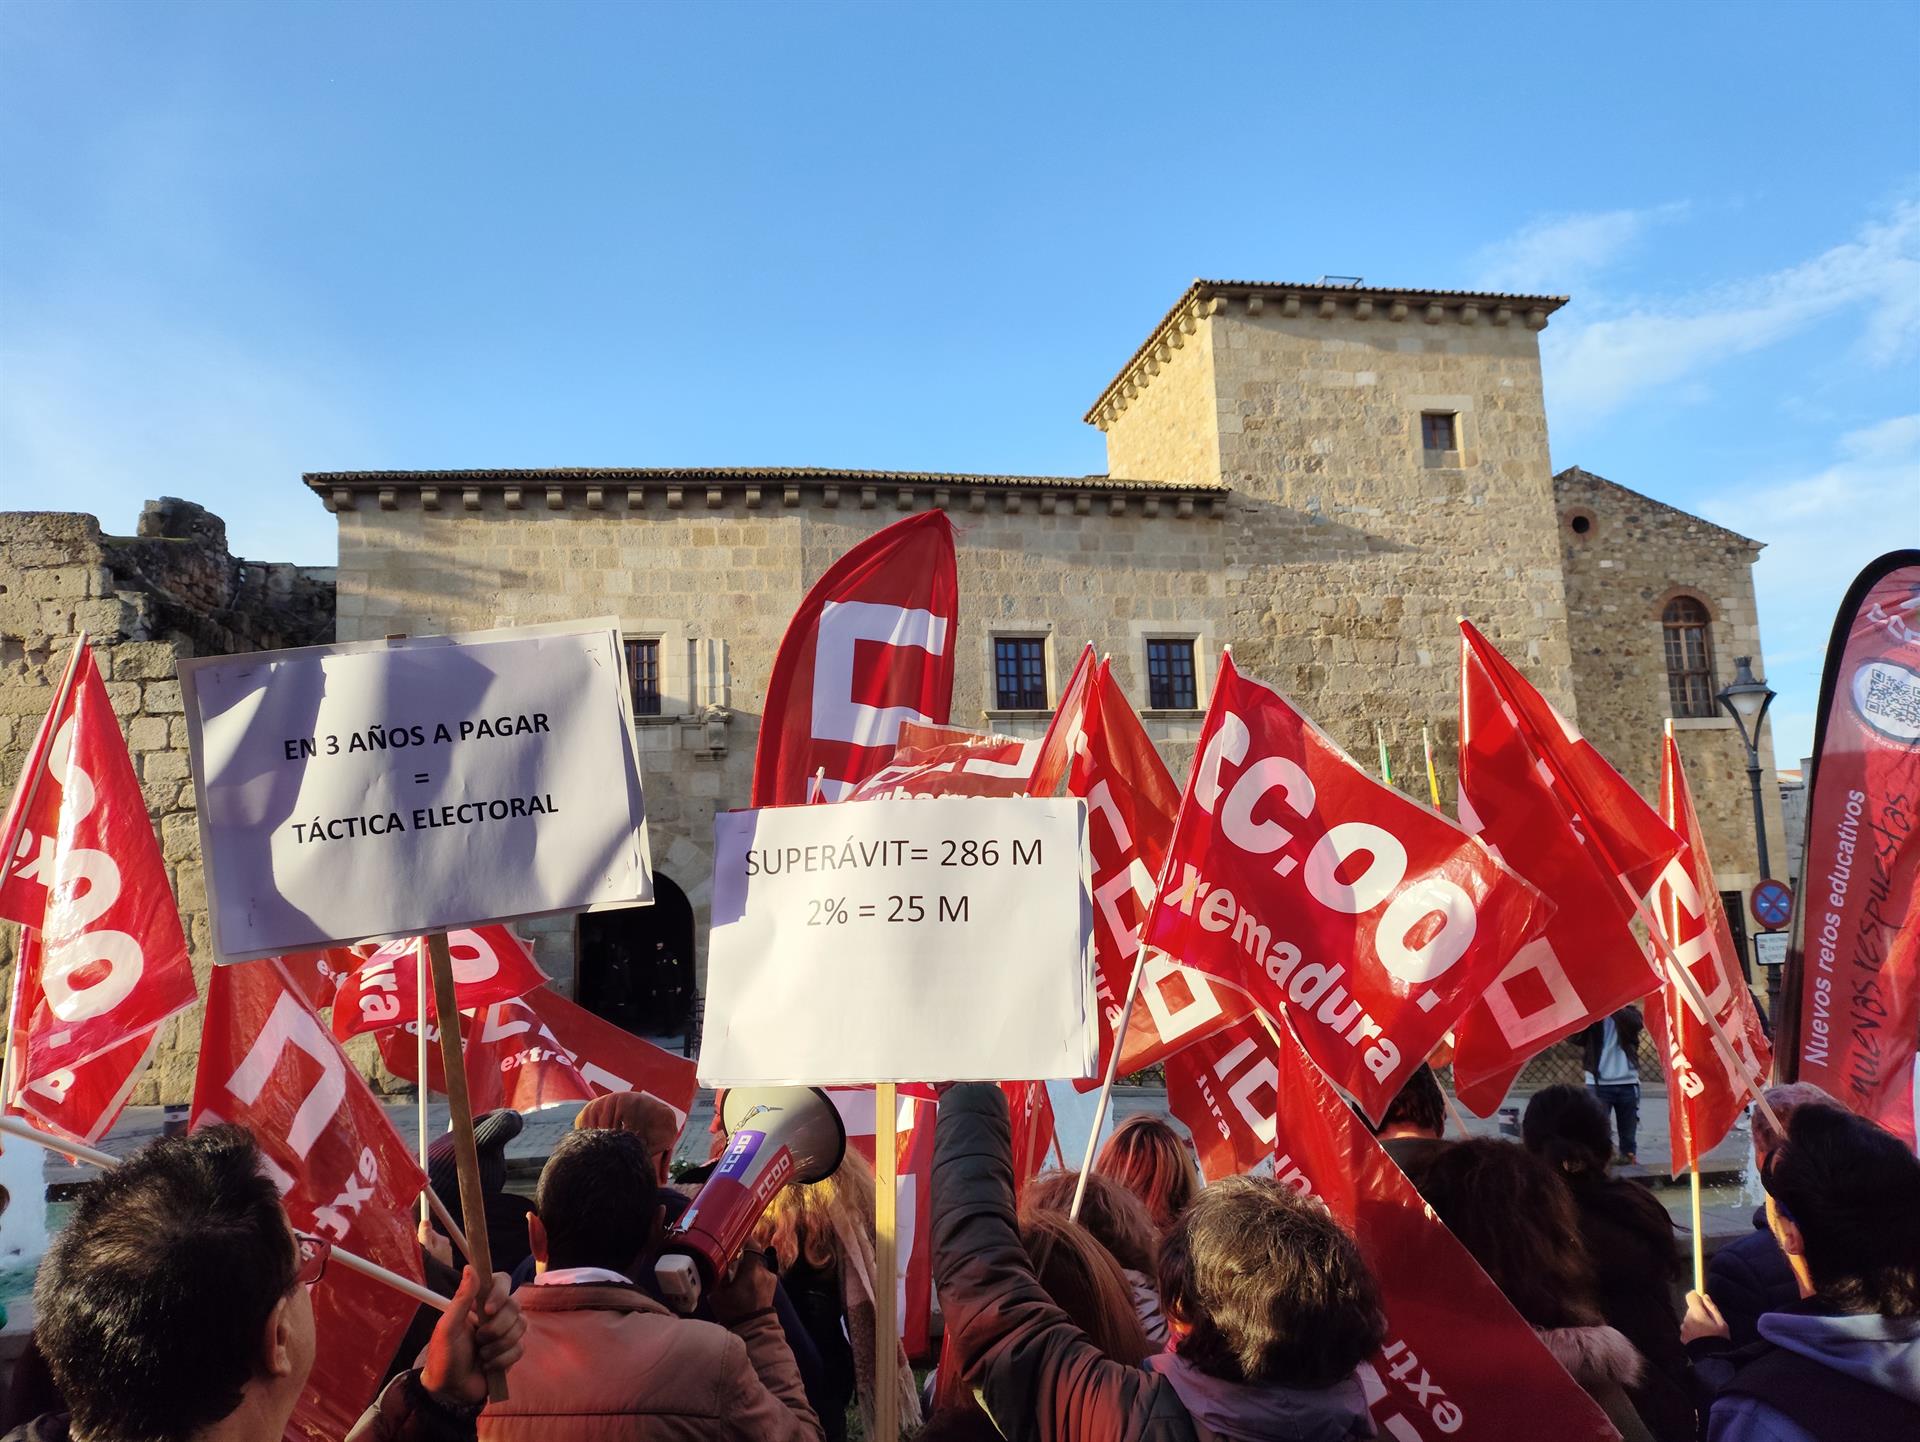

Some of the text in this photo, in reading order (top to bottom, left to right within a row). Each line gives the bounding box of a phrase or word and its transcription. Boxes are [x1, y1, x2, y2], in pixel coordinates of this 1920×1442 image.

[283, 713, 551, 760] EN 3 AÑOS A PAGAR
[414, 772, 430, 784] =
[292, 794, 560, 844] TÁCTICA ELECTORAL
[940, 839, 1000, 866] 286
[1012, 838, 1042, 866] M
[1853, 791, 1911, 973] respuestas
[806, 896, 970, 926] 2% = 25 M
[1804, 789, 1866, 1067] Nuevos retos educativos
[756, 1153, 790, 1201] CCOO
